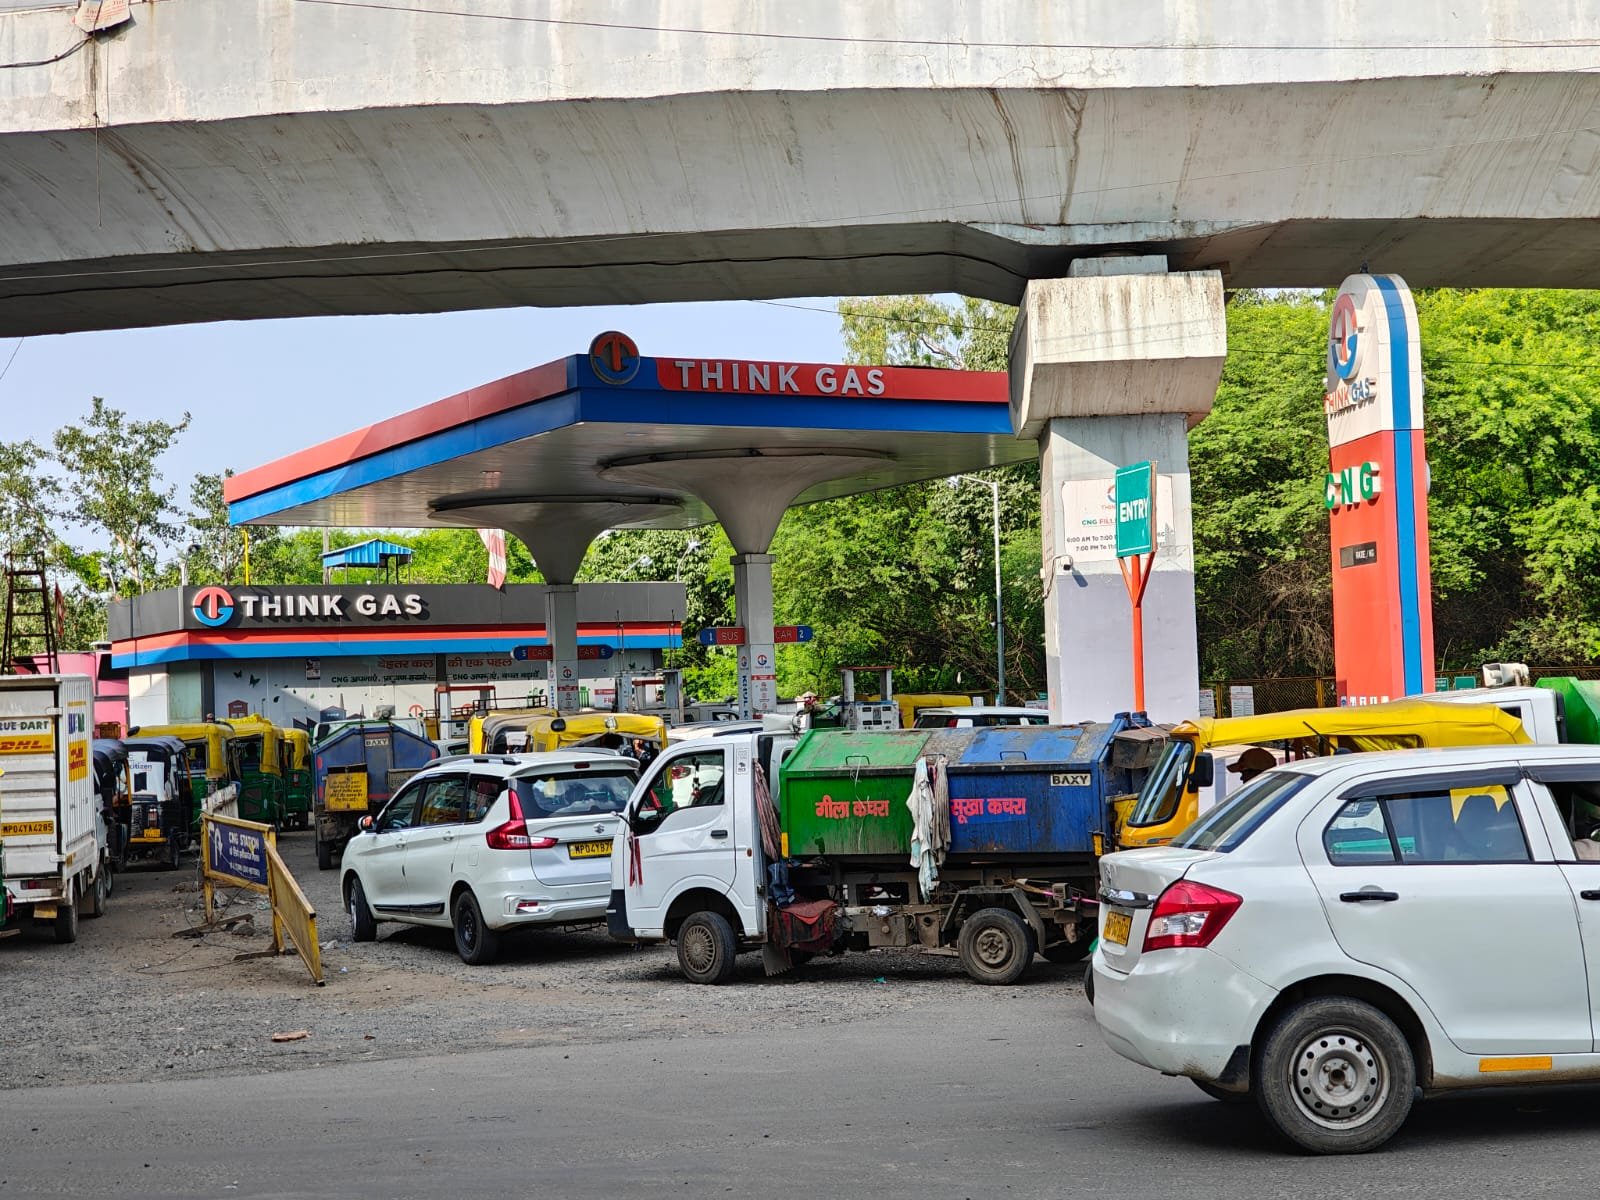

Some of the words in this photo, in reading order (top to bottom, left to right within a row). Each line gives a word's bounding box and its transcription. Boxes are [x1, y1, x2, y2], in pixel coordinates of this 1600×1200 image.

[675, 361, 800, 392] THINK
[815, 368, 885, 395] GAS
[1323, 383, 1351, 415] THINK
[1351, 377, 1377, 402] GAS
[1324, 461, 1382, 510] CNG
[1120, 498, 1148, 523] ENTRY
[240, 595, 344, 617] THINK
[356, 594, 423, 616] GAS
[709, 631, 714, 642] 1
[775, 631, 793, 640] CAR
[798, 629, 805, 639] 2
[412, 658, 434, 668] कल
[447, 657, 463, 668] की
[466, 659, 483, 667] एक
[487, 657, 512, 667] पहल
[20, 721, 49, 730] DART
[0, 741, 42, 750] DHL
[1052, 774, 1089, 785] BAXY
[815, 795, 850, 818] गीला
[852, 799, 890, 817] कचरा
[950, 798, 984, 824] सूखा
[987, 798, 1026, 815] कचरा
